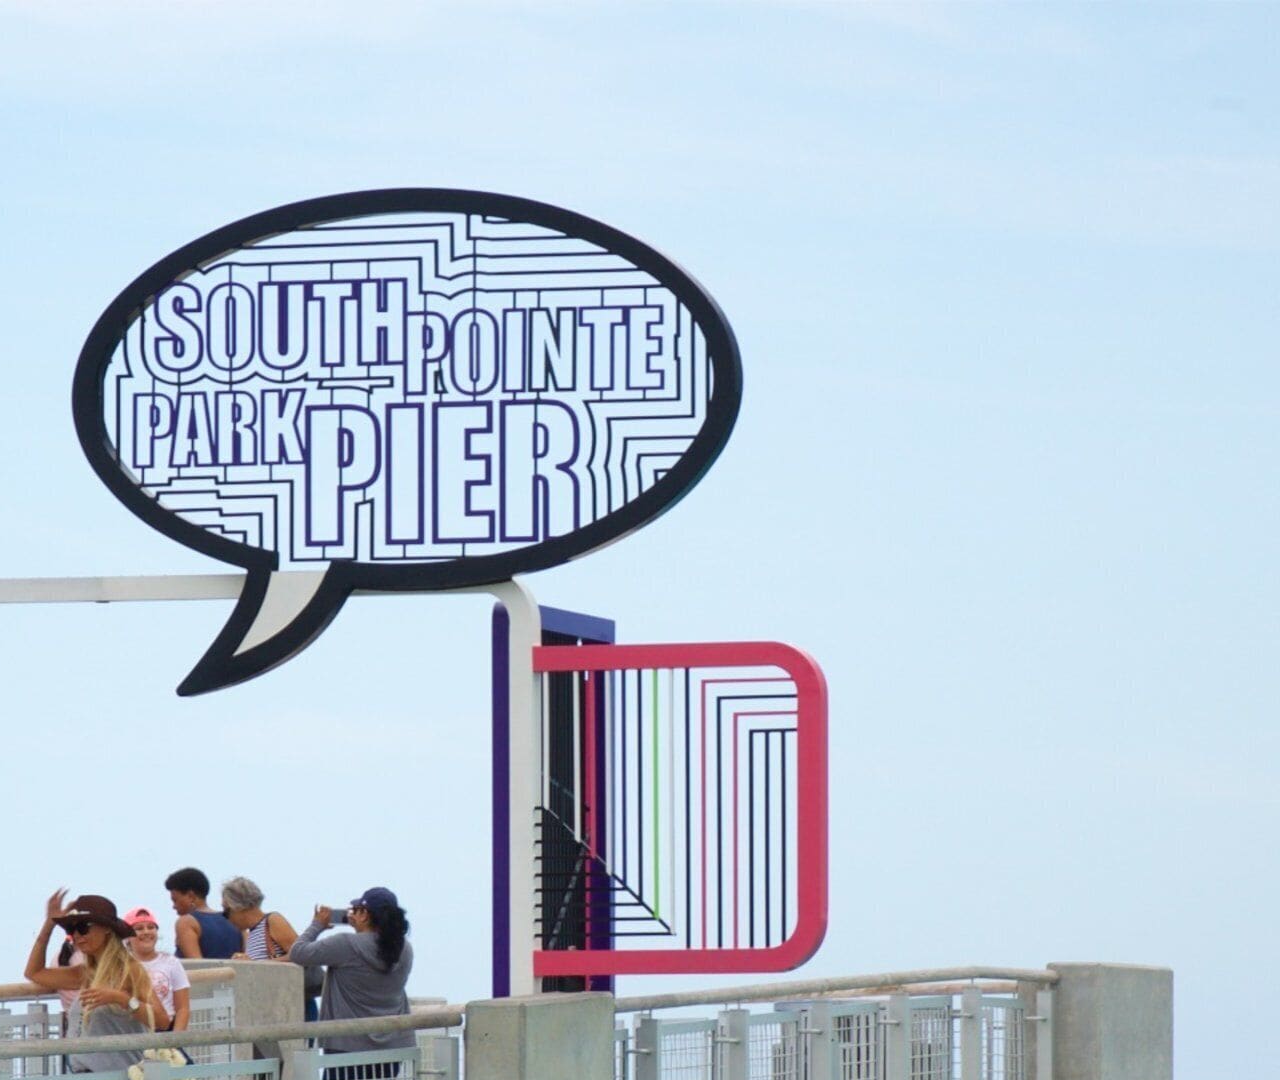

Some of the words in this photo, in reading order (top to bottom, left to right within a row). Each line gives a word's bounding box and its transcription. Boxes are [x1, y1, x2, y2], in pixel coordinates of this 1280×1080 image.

[153, 278, 407, 374] SOUTH
[404, 306, 665, 396] POINTE
[132, 388, 307, 469] PARK
[304, 400, 581, 547] PIER
